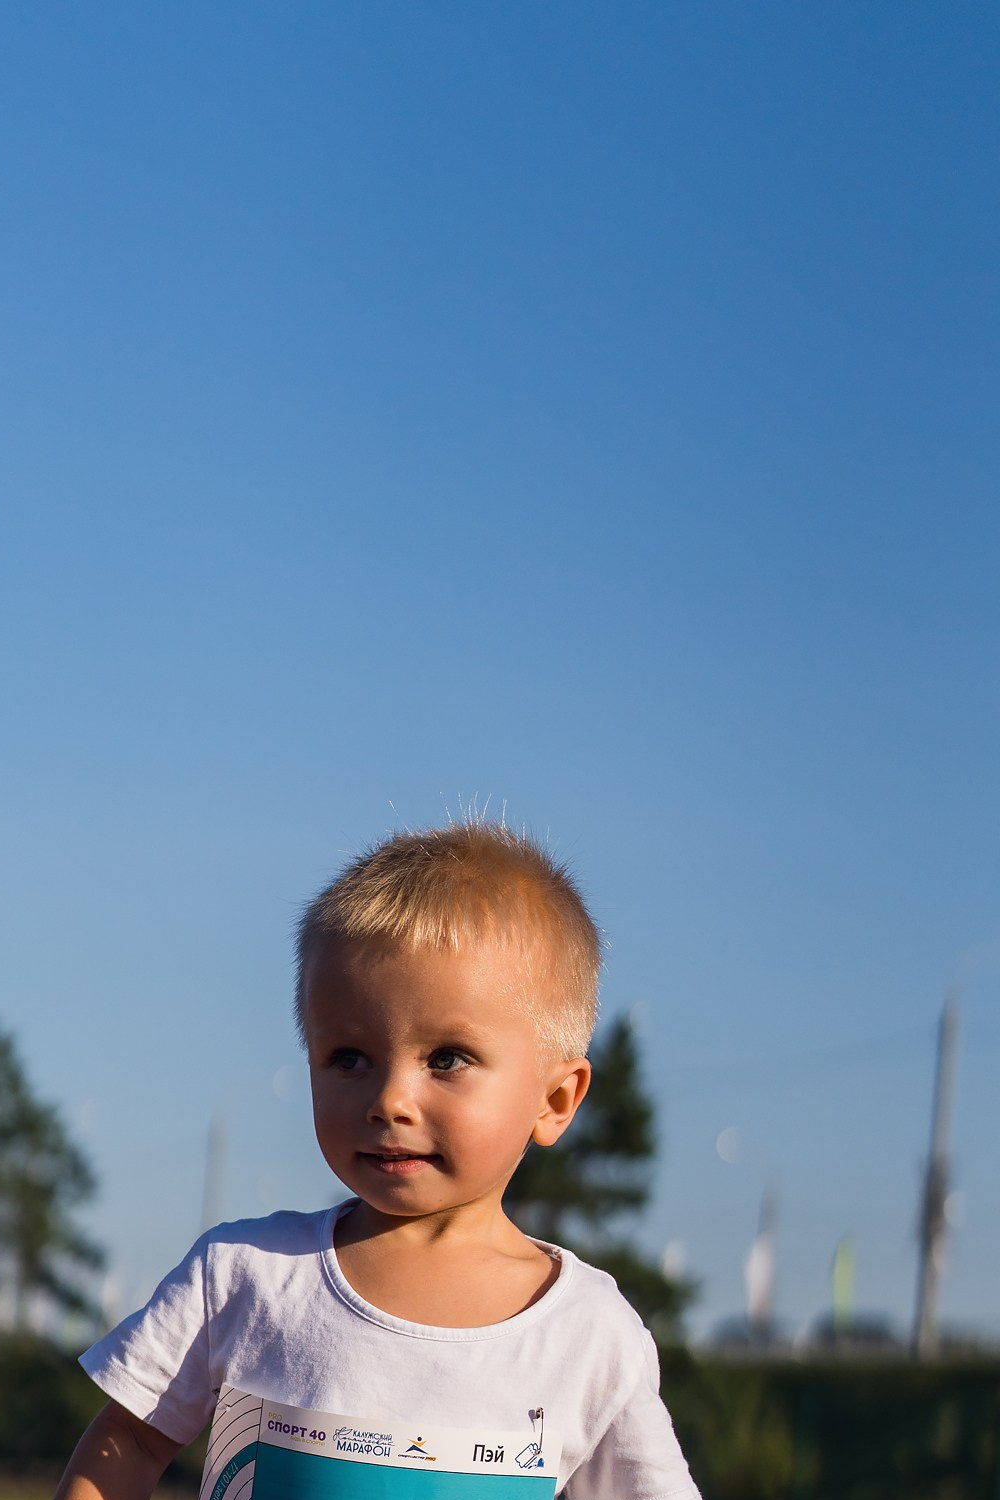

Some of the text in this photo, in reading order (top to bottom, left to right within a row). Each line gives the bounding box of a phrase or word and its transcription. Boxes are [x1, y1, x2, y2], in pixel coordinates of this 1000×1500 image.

[267, 1420, 326, 1441] СПОРТ 40
[352, 1429, 393, 1442] КАЛУЖСКИЙ
[336, 1440, 391, 1458] МАРАФОН
[472, 1444, 505, 1463] Пэй
[222, 1461, 239, 1484] 17:10
